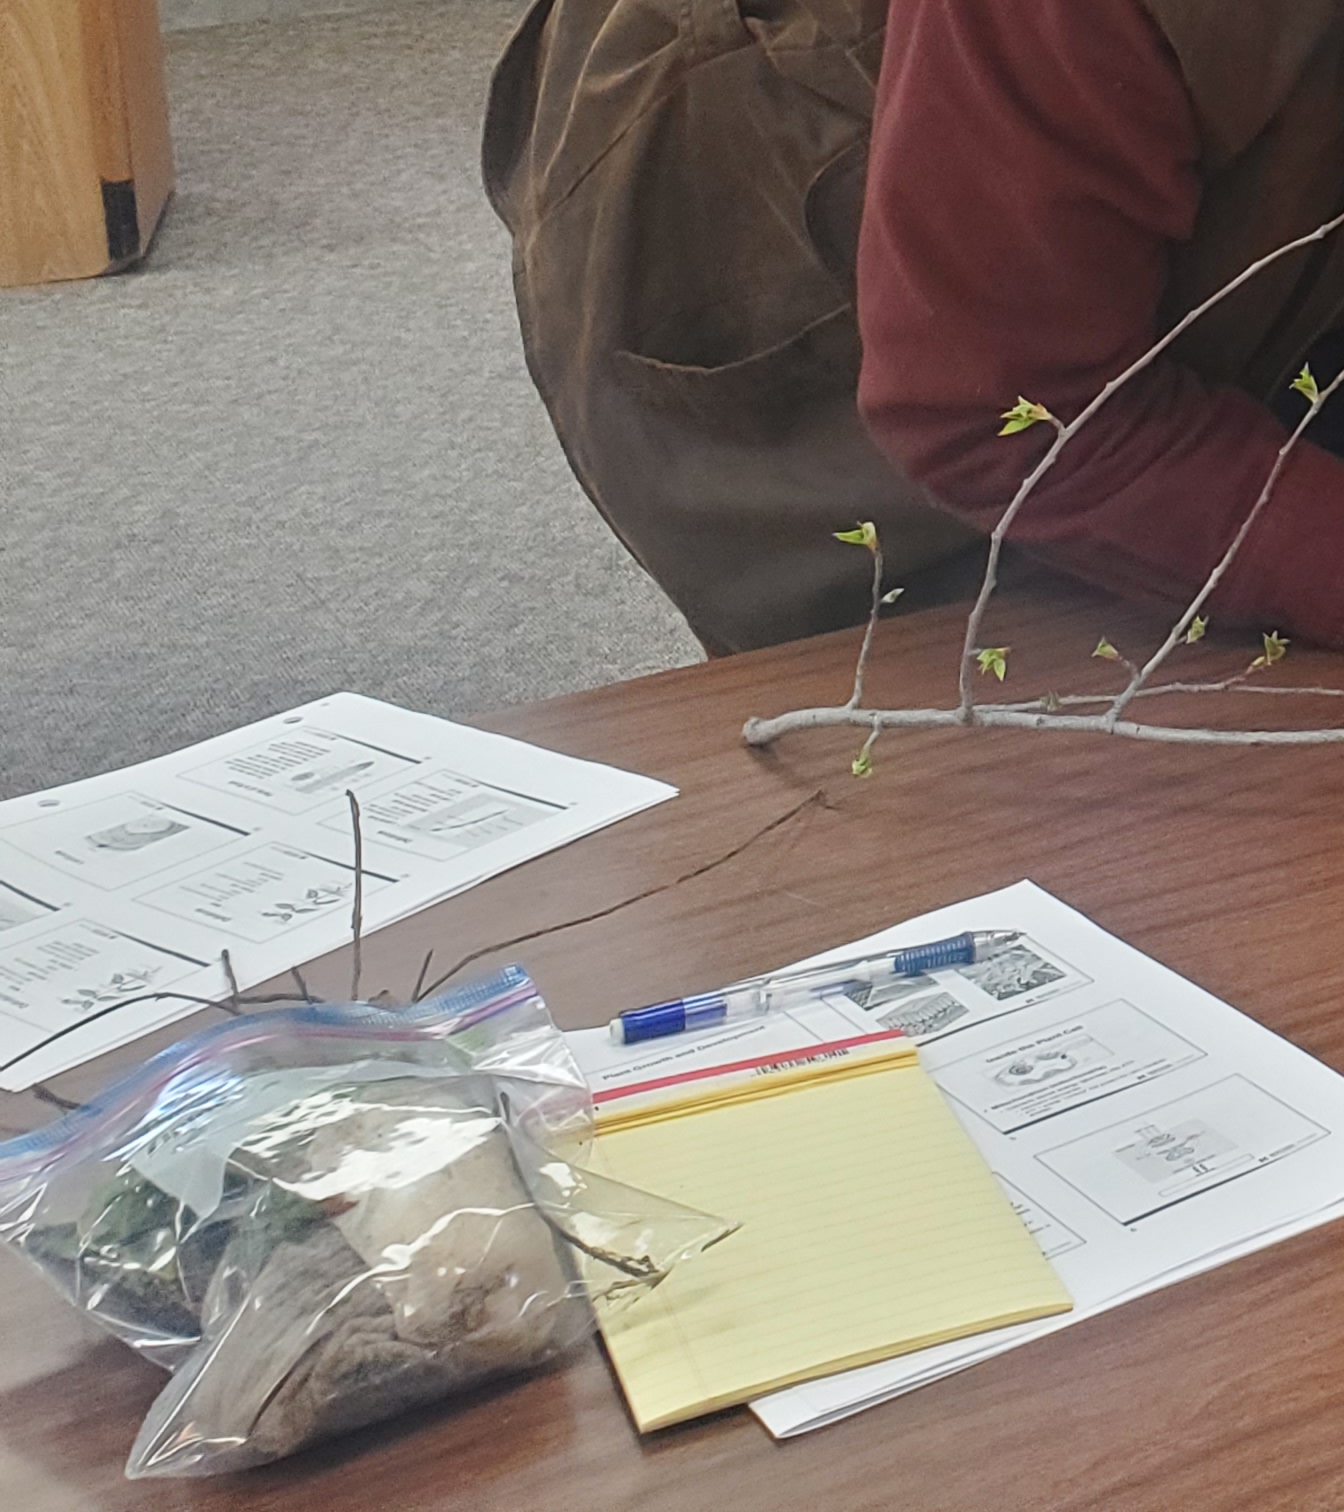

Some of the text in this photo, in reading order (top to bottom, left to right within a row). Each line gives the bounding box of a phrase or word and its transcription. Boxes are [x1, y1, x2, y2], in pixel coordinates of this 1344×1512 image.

[602, 1024, 766, 1081] Plant Growth and Development
